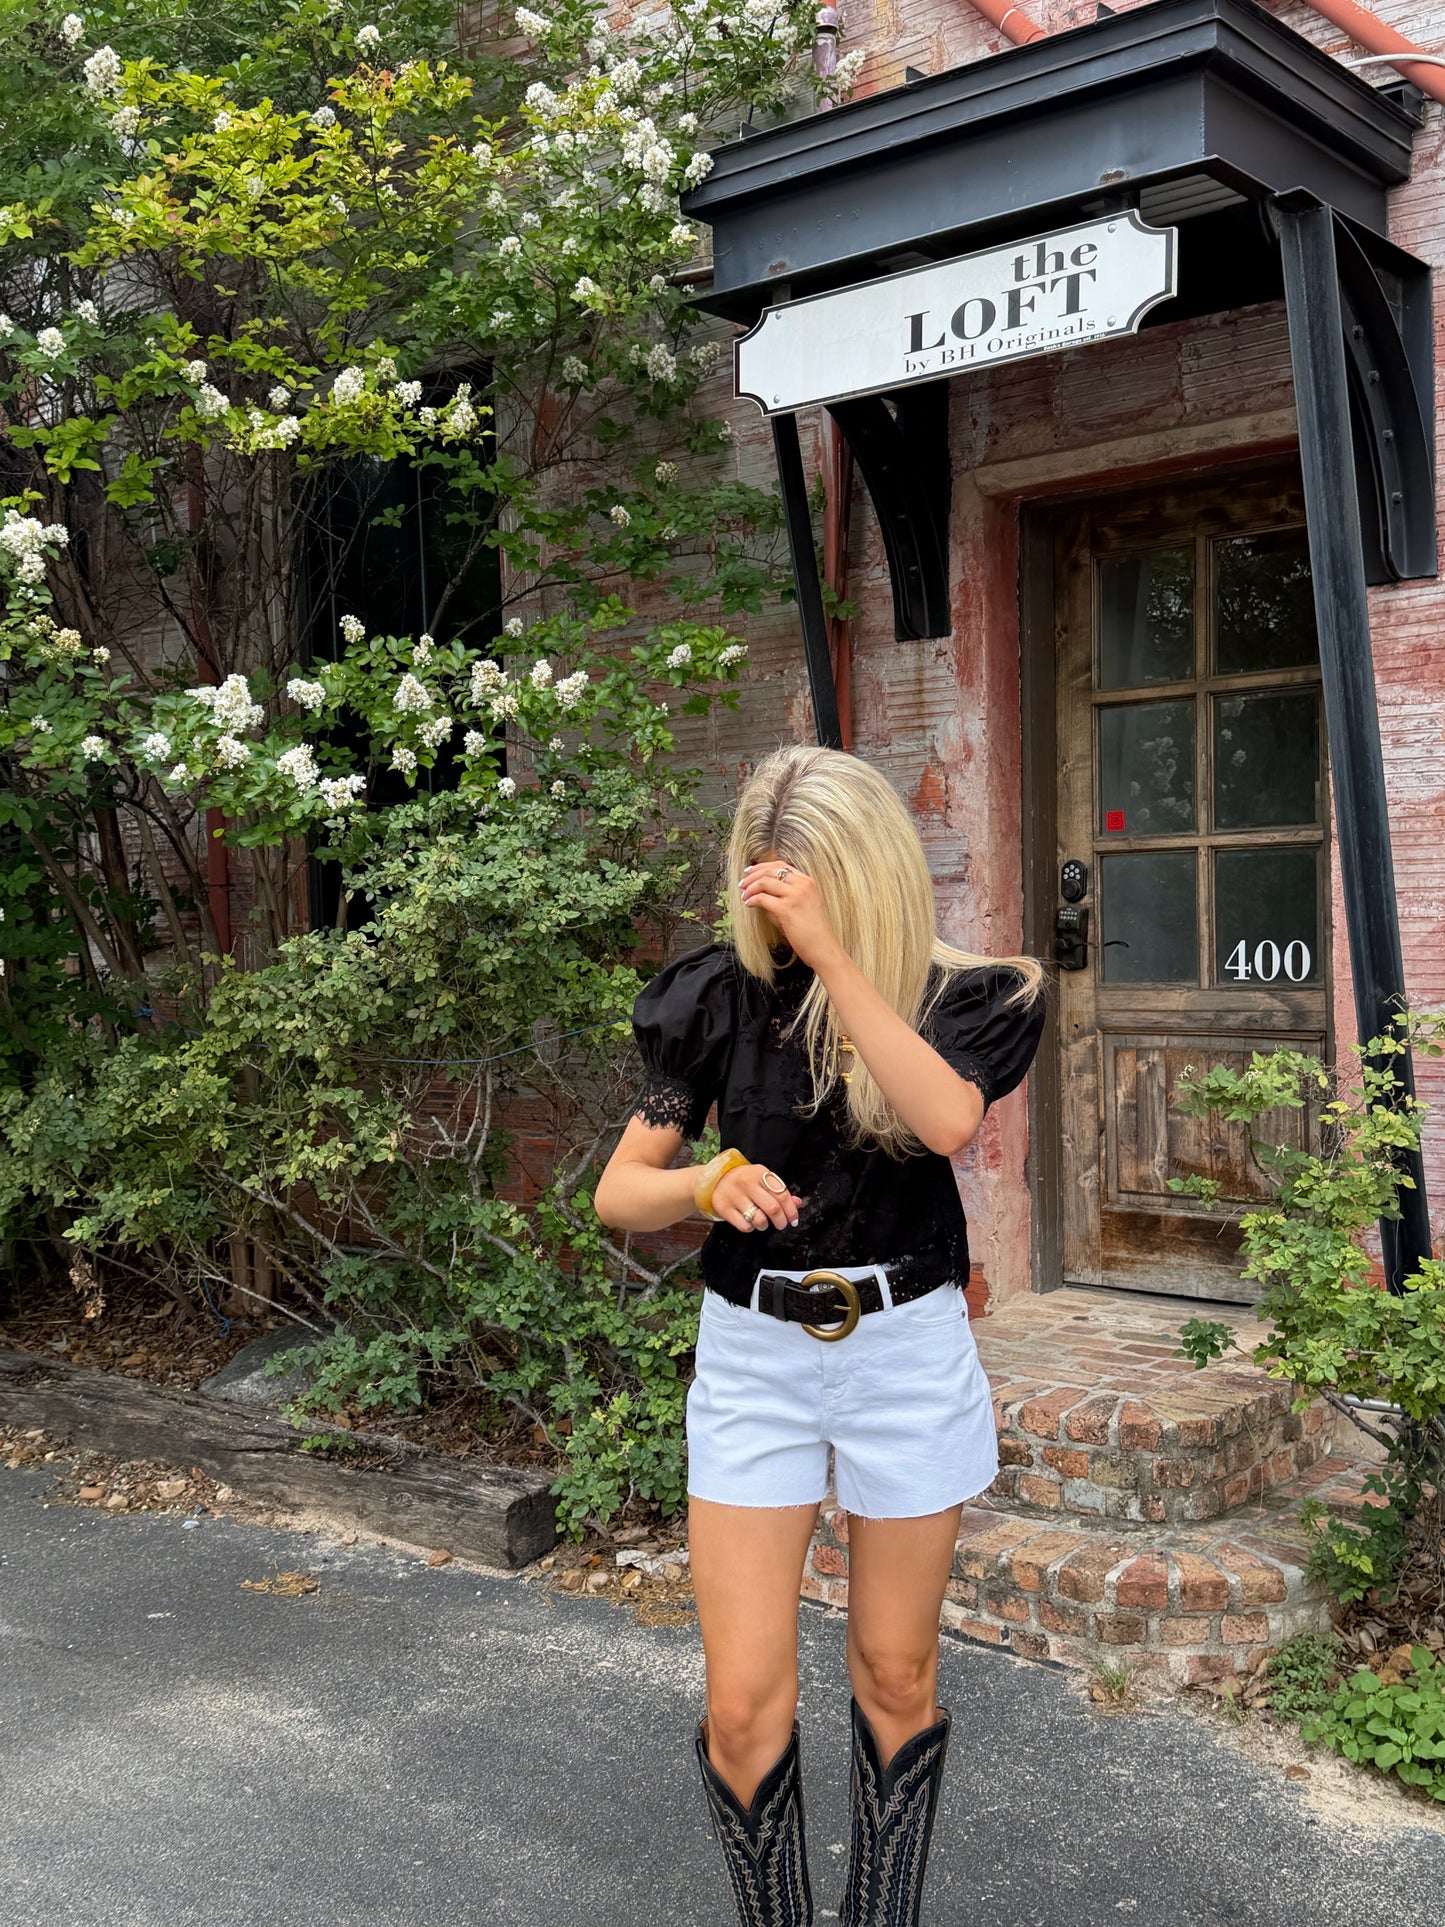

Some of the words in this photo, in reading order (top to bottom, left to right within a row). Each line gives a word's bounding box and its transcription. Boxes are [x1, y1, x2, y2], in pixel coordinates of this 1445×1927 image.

[1010, 241, 1098, 283] the
[903, 269, 1097, 355] LOFT
[903, 357, 930, 374] by
[938, 344, 977, 366] BH
[986, 316, 1096, 353] Originals
[1224, 939, 1311, 982] 400
